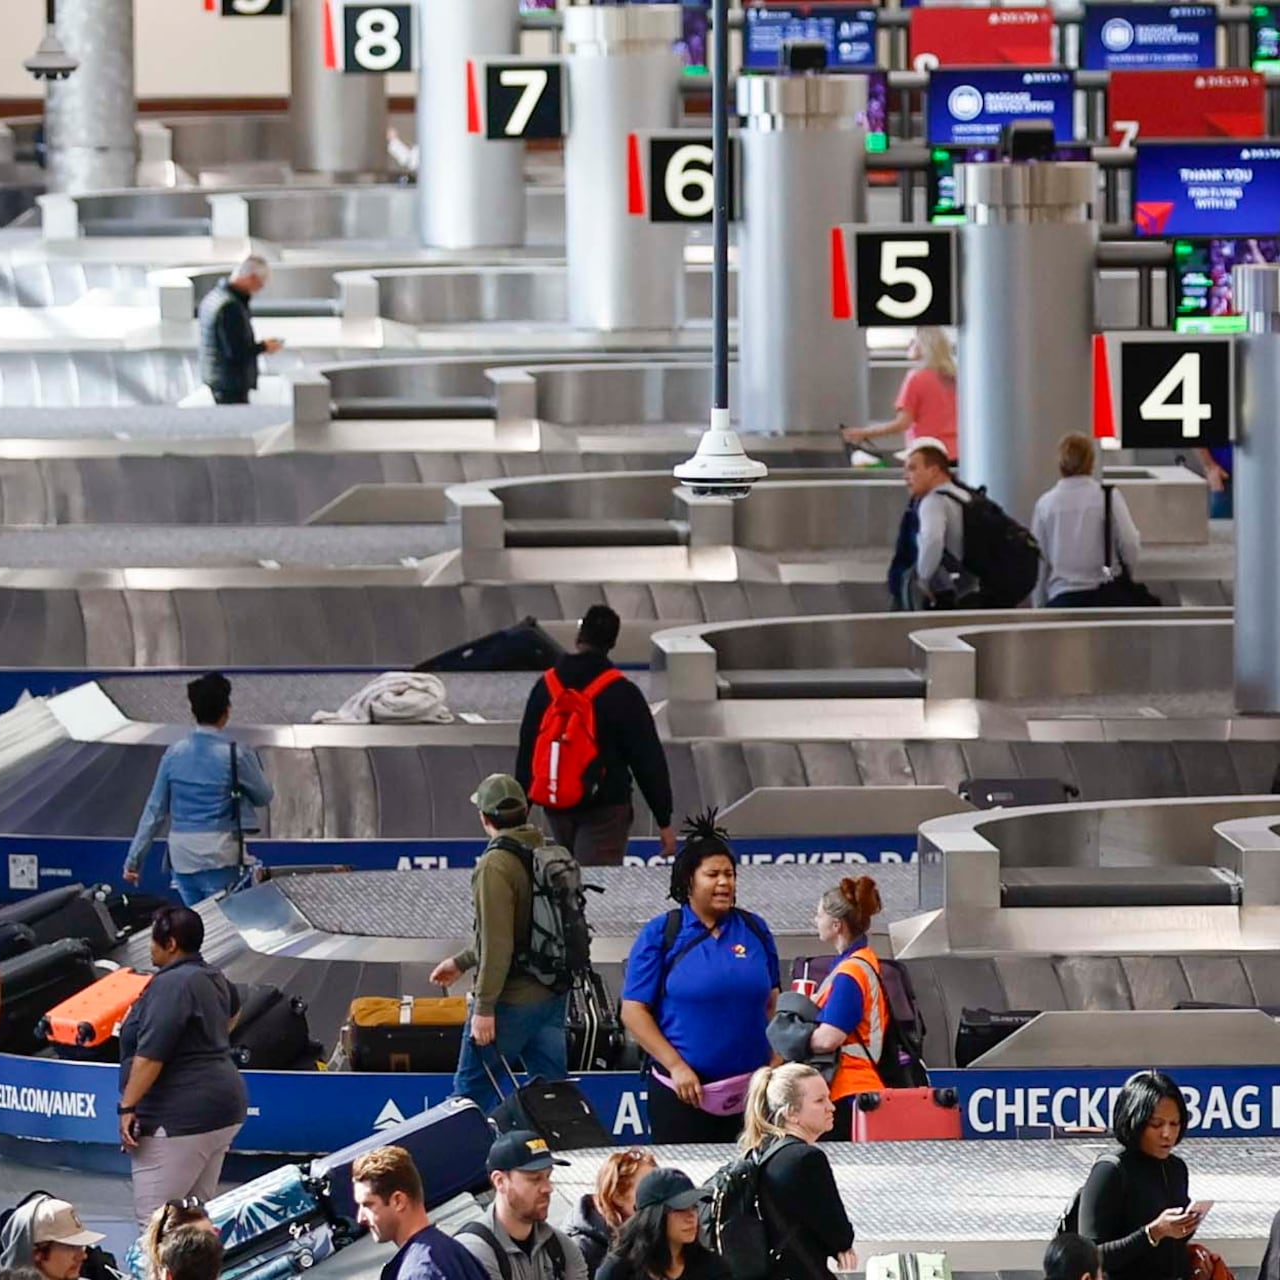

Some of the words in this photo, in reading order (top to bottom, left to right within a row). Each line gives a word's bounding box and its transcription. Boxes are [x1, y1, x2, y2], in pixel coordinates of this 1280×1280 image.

[354, 8, 402, 71] 8
[499, 69, 549, 136] 7
[1113, 121, 1140, 149] 7
[664, 144, 715, 218] 6
[874, 241, 934, 320] 5
[1139, 352, 1212, 438] 4
